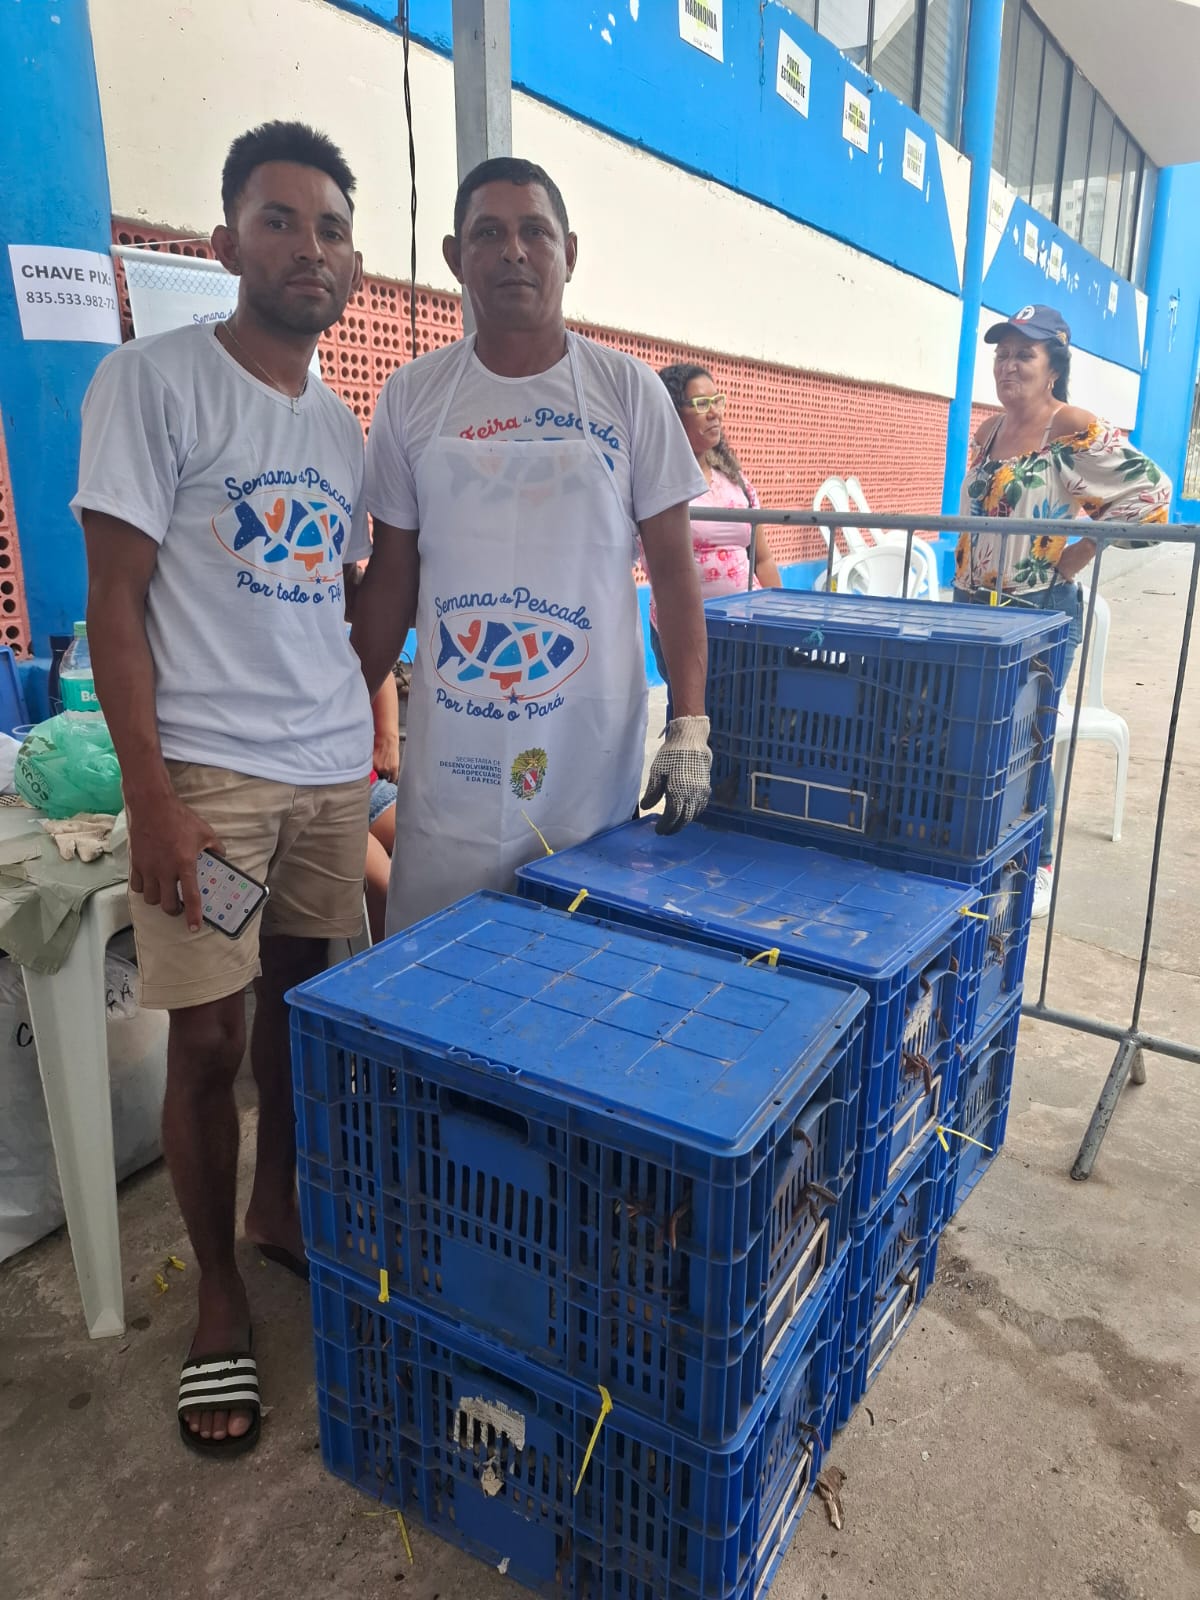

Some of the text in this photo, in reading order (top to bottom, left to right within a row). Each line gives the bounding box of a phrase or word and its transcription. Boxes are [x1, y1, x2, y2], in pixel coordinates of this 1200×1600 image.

[21, 264, 112, 286] CHAVE PIX:
[26, 291, 116, 310] 835.533.982-72
[224, 469, 298, 500] Semana
[237, 571, 273, 597] Por
[276, 582, 310, 604] todo
[312, 593, 325, 604] o
[434, 587, 593, 630] Semana do Pescado
[436, 688, 565, 722] Por todo o Pará
